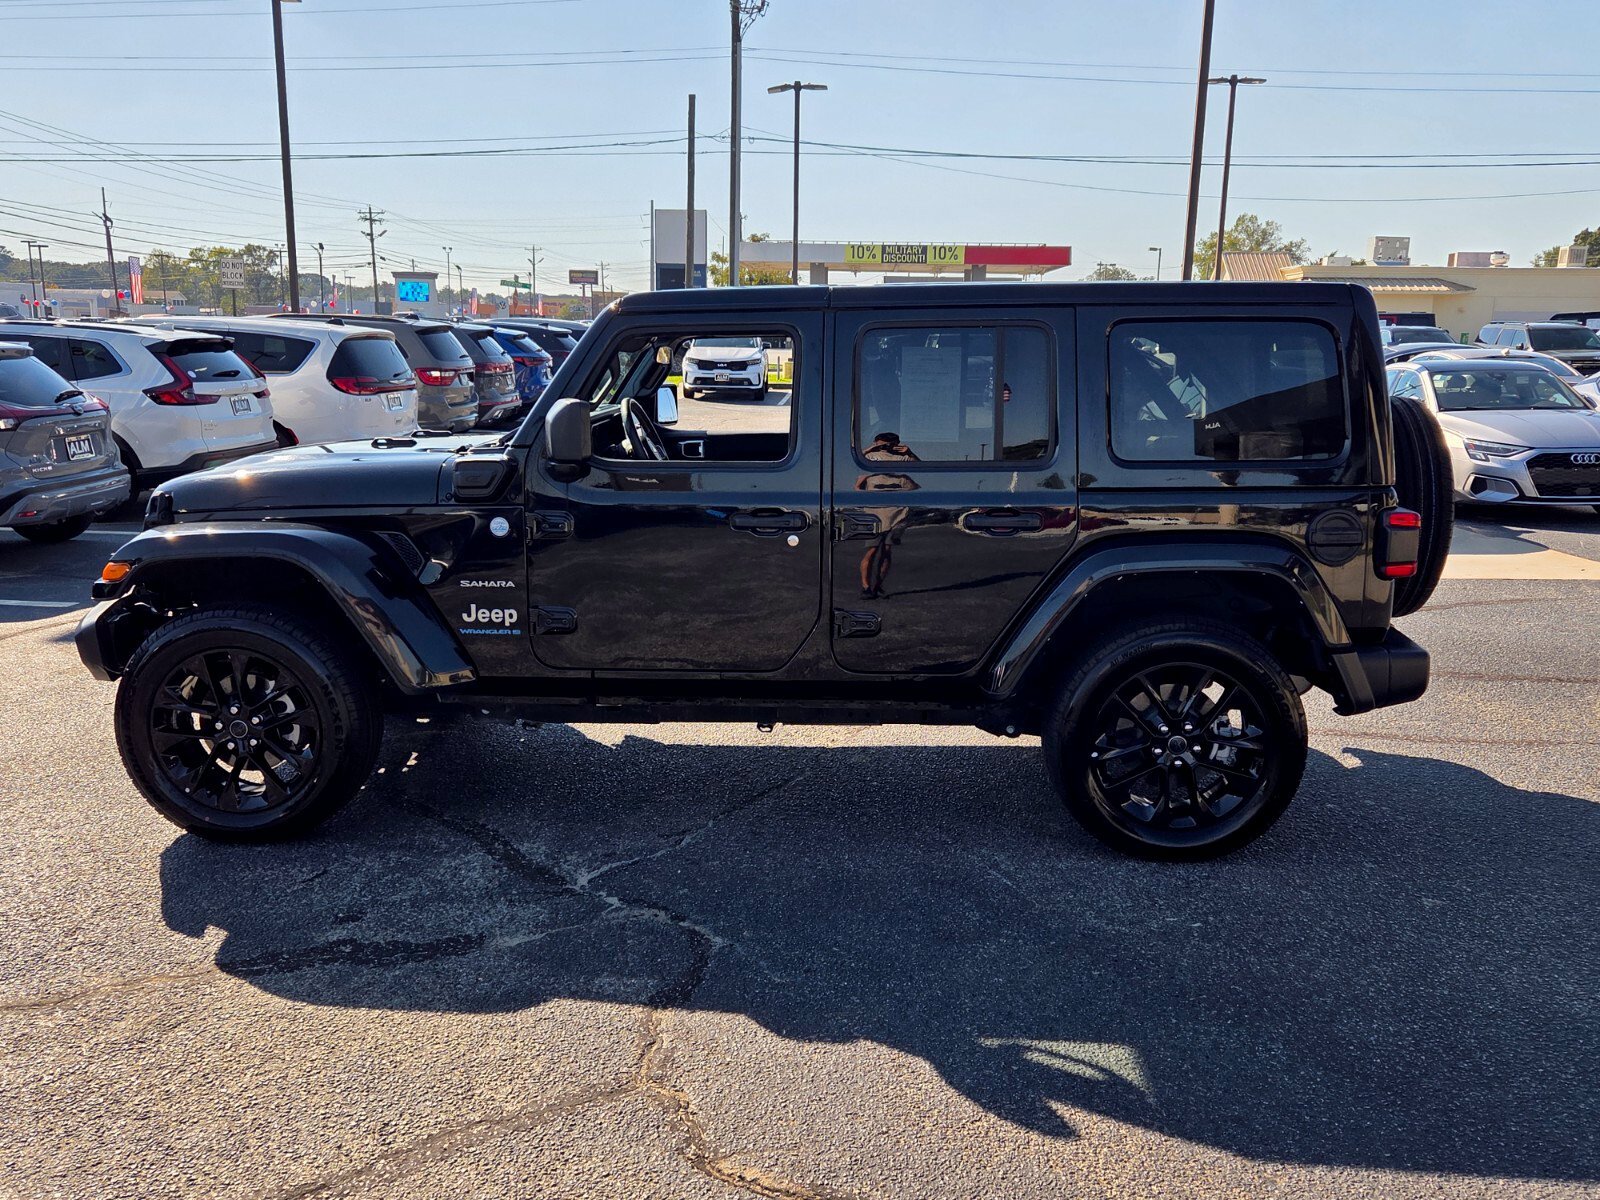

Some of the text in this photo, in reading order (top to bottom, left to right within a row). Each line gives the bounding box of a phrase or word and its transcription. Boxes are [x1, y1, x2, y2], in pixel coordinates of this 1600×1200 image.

[850, 245, 877, 260] 10%
[885, 245, 922, 254] MILITARY
[932, 245, 959, 260] 10%
[883, 254, 926, 263] DISCOUNT!
[221, 261, 243, 270] DO NOT
[222, 271, 244, 280] BLOCK
[70, 439, 91, 455] ALM
[460, 580, 516, 588] SAHARA
[461, 603, 518, 627] Jeep
[321, 683, 345, 752] NEXEN
